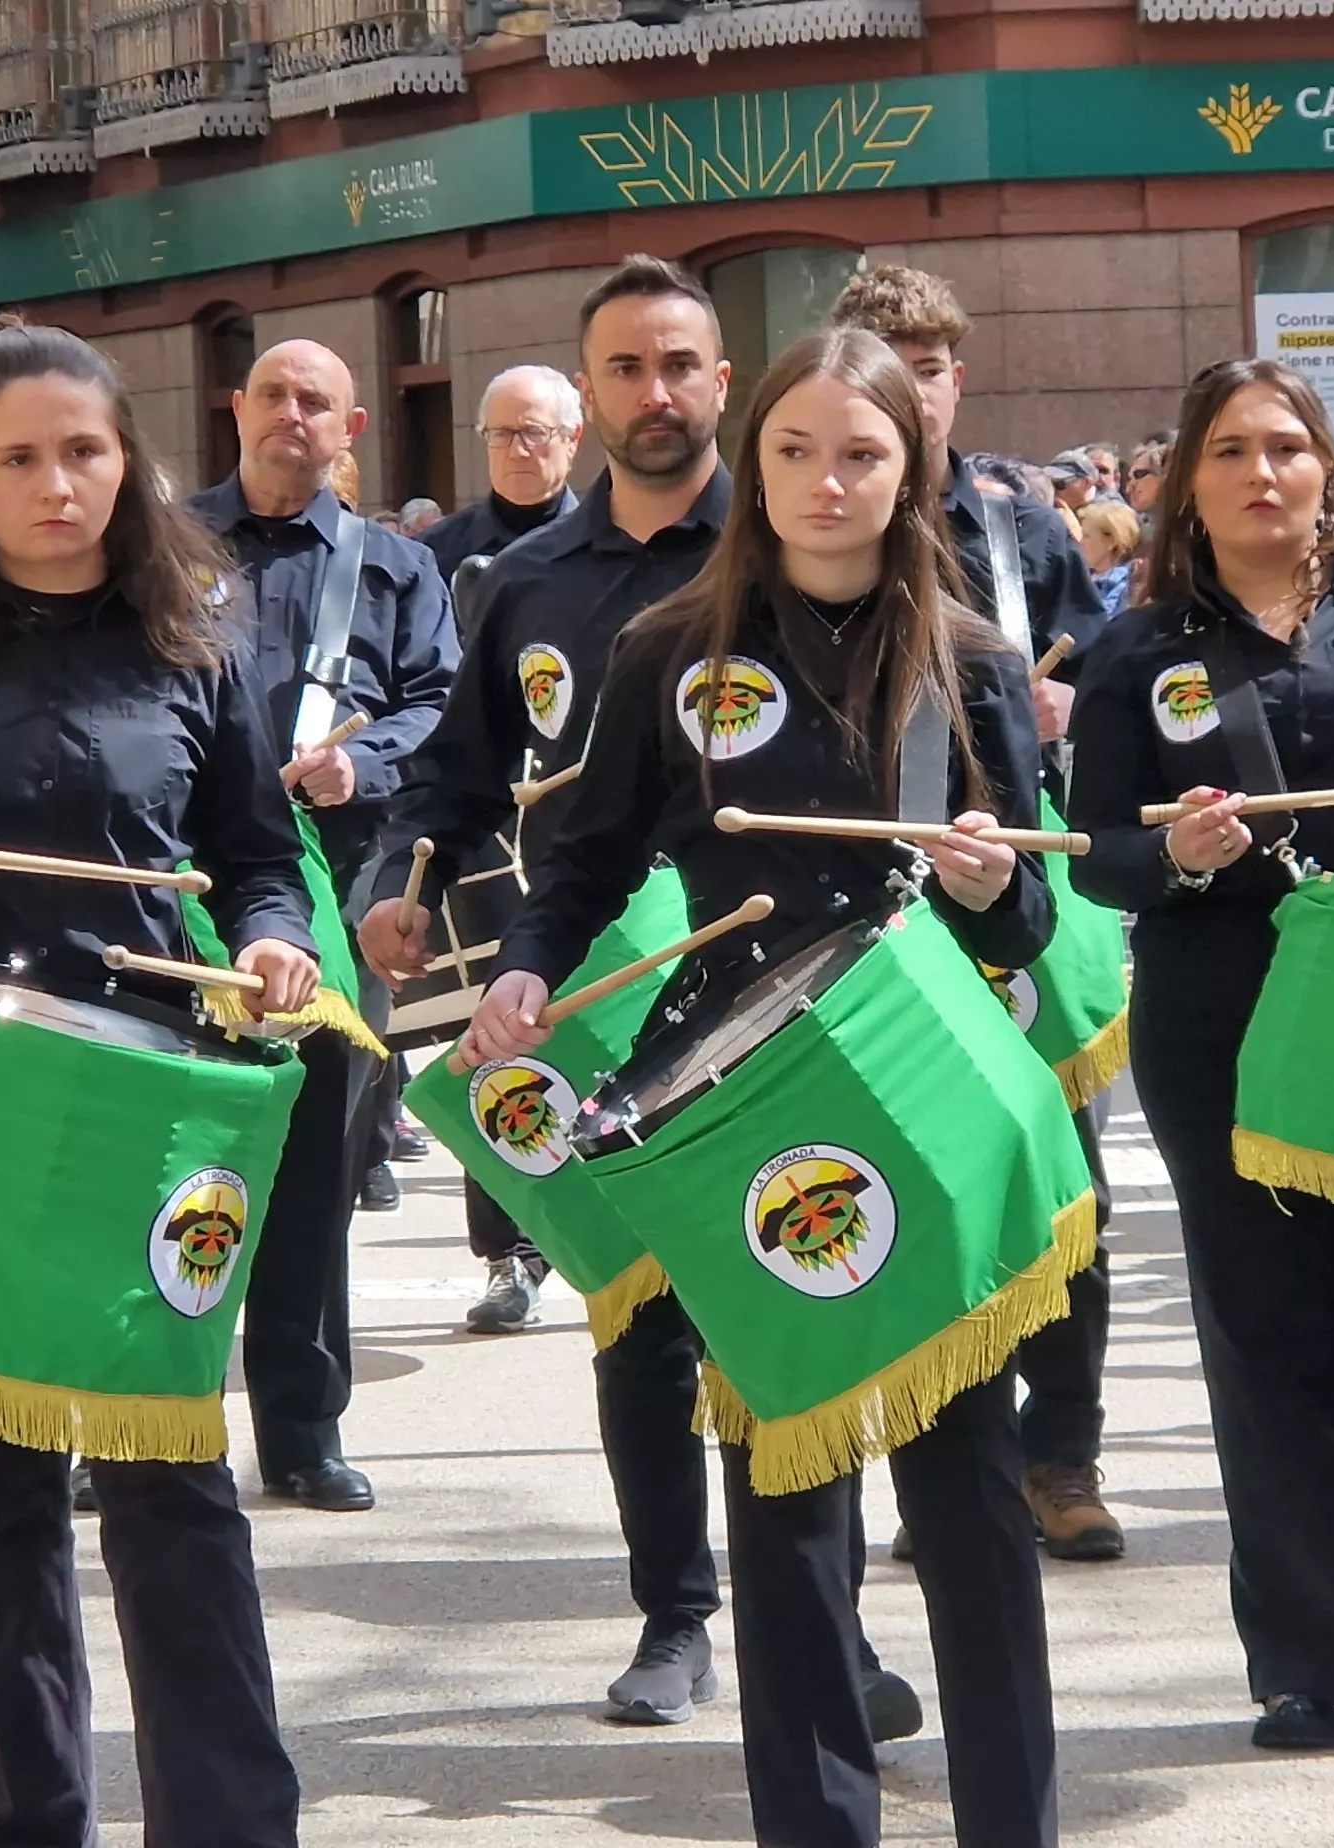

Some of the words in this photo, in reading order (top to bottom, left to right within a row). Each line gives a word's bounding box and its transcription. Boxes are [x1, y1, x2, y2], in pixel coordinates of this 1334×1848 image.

[190, 1176, 203, 1188] LA
[751, 1178, 763, 1193] LA
[762, 1147, 817, 1178] TRONADA
